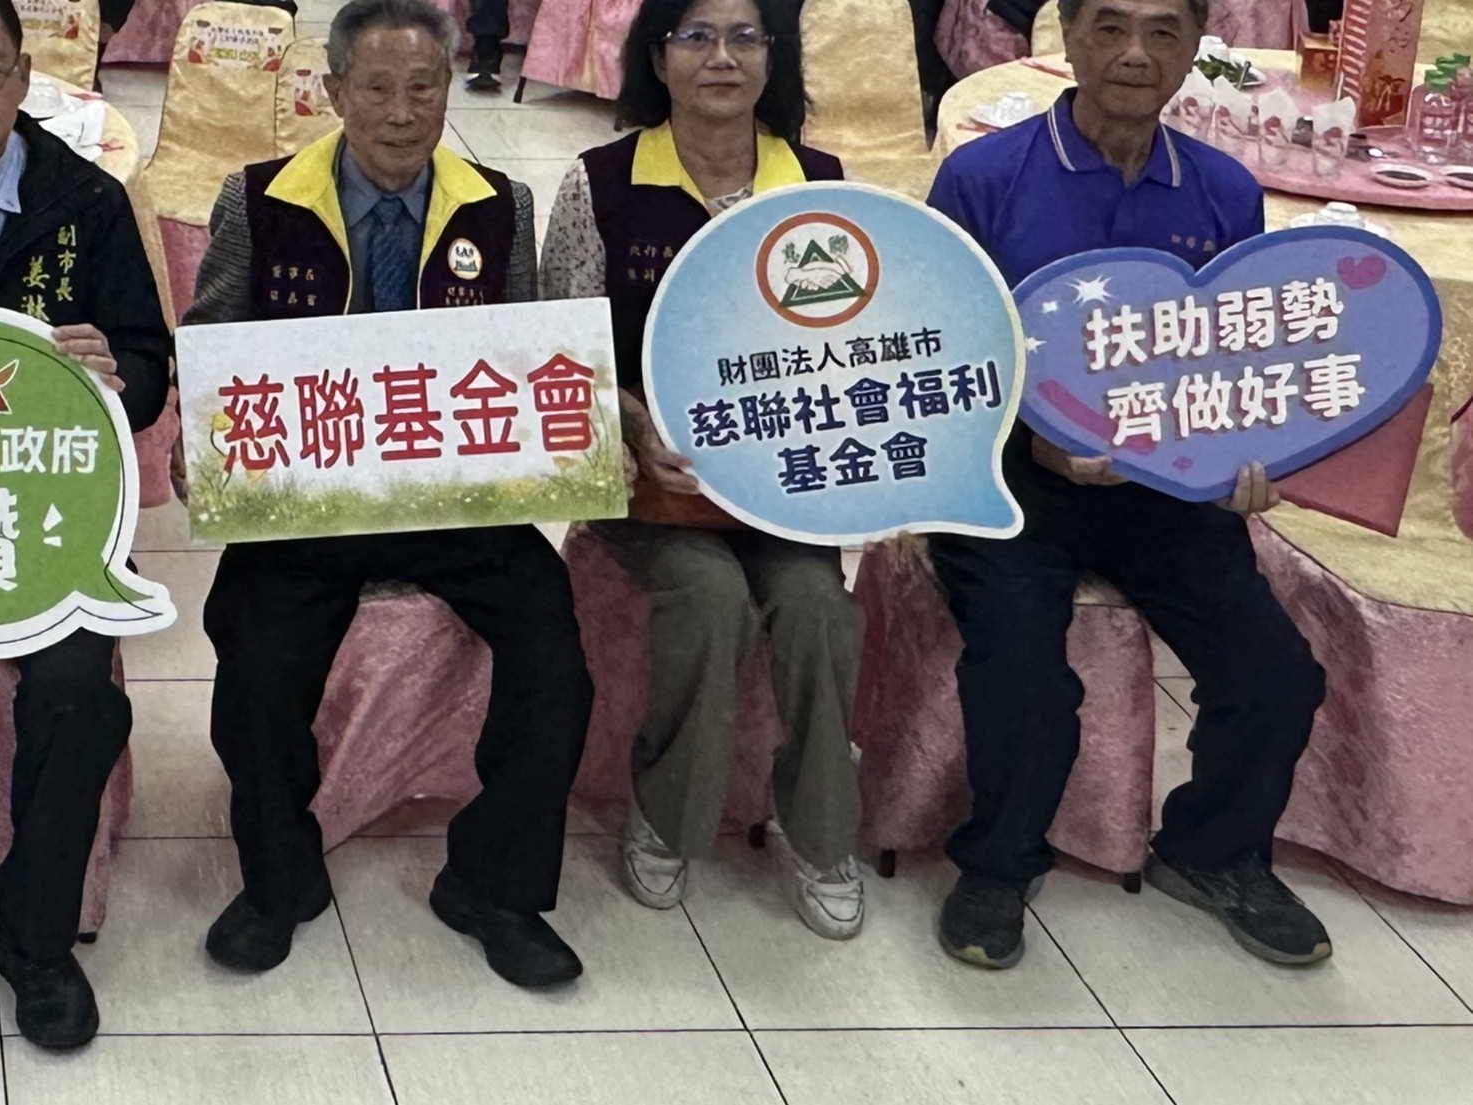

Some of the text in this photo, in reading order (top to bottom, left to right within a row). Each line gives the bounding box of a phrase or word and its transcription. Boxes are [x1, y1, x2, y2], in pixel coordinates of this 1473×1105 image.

[56, 224, 77, 302] 副市長
[717, 326, 942, 386] 財團法人高雄市
[1086, 277, 1345, 372] 扶助弱勢
[218, 353, 595, 472] 慈聯基金會
[687, 360, 1003, 450] 慈聯社會福利
[1106, 353, 1365, 447] 齊做好事
[777, 430, 929, 495] 基金會
